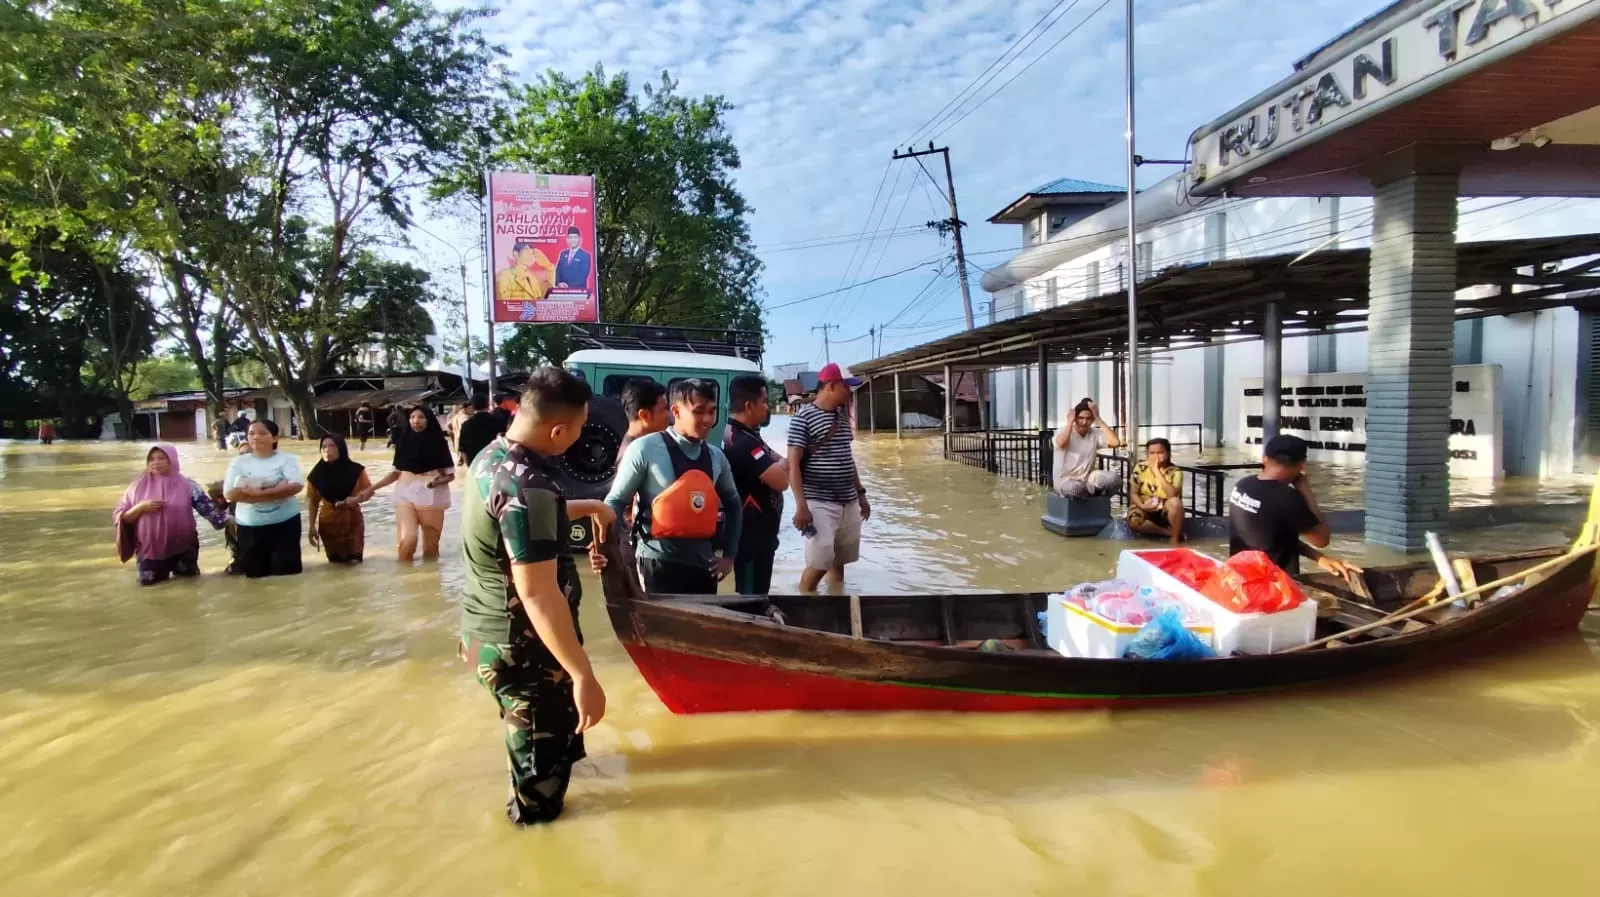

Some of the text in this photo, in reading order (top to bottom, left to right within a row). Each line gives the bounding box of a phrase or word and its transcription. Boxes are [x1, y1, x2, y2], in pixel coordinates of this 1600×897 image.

[1218, 0, 1562, 167] RUTAN TA
[496, 213, 575, 226] PAHLAWAN
[496, 225, 566, 237] NASIONAL
